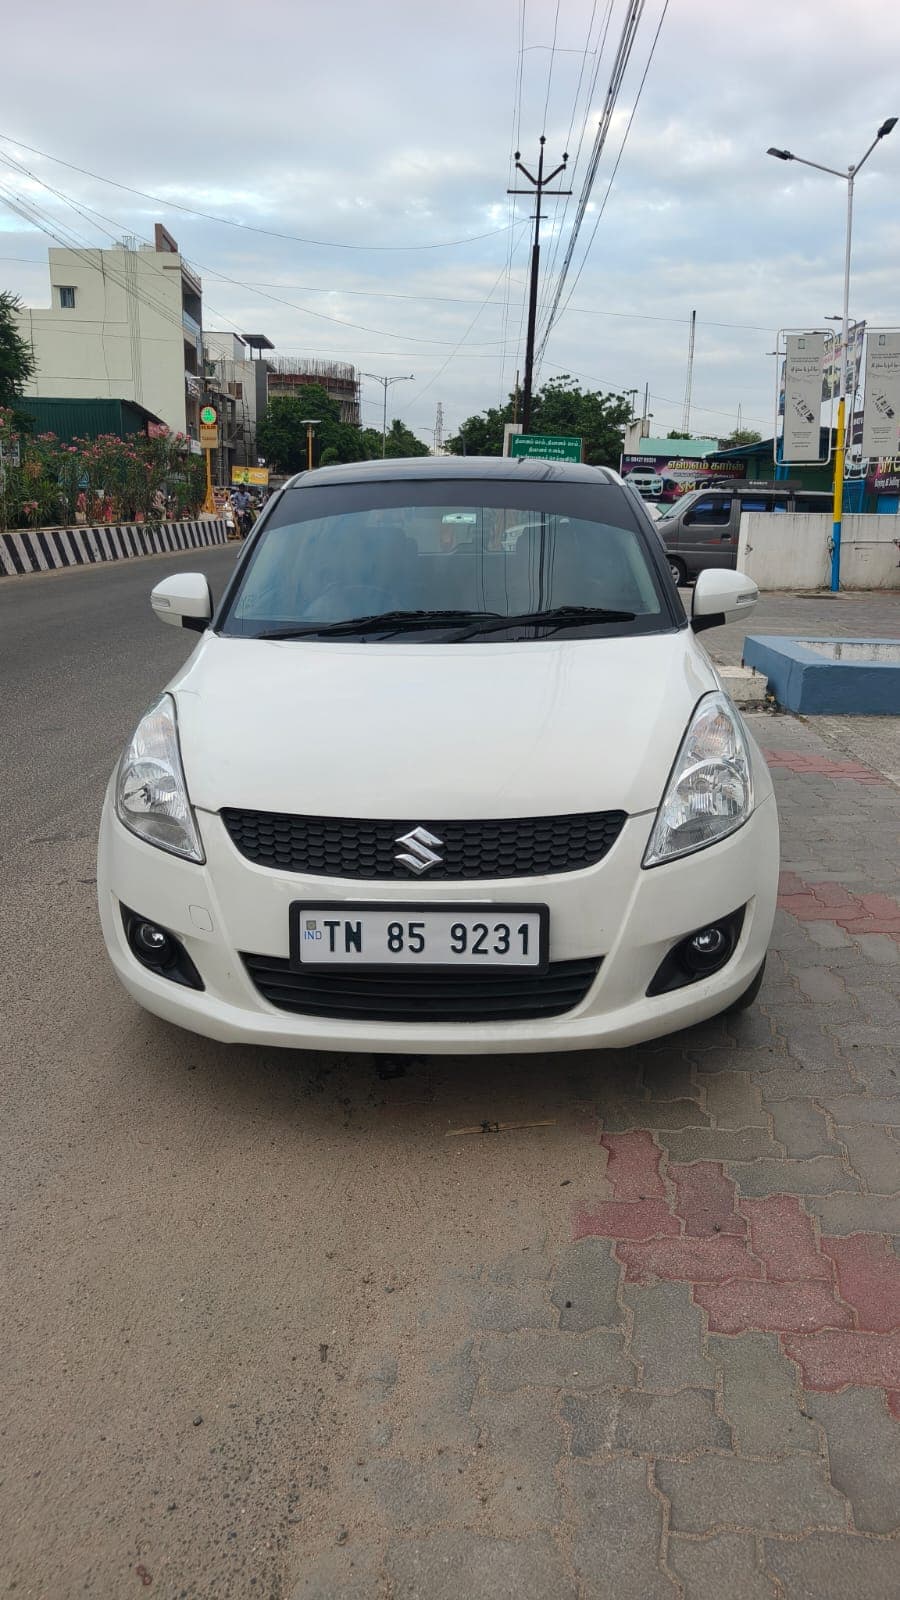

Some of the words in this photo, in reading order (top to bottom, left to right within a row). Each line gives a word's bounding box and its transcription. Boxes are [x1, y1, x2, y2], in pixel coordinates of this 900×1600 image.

[679, 481, 696, 493] SM
[304, 931, 322, 940] IND
[324, 921, 362, 953] TN
[387, 922, 425, 954] 85
[450, 923, 529, 955] 9231
